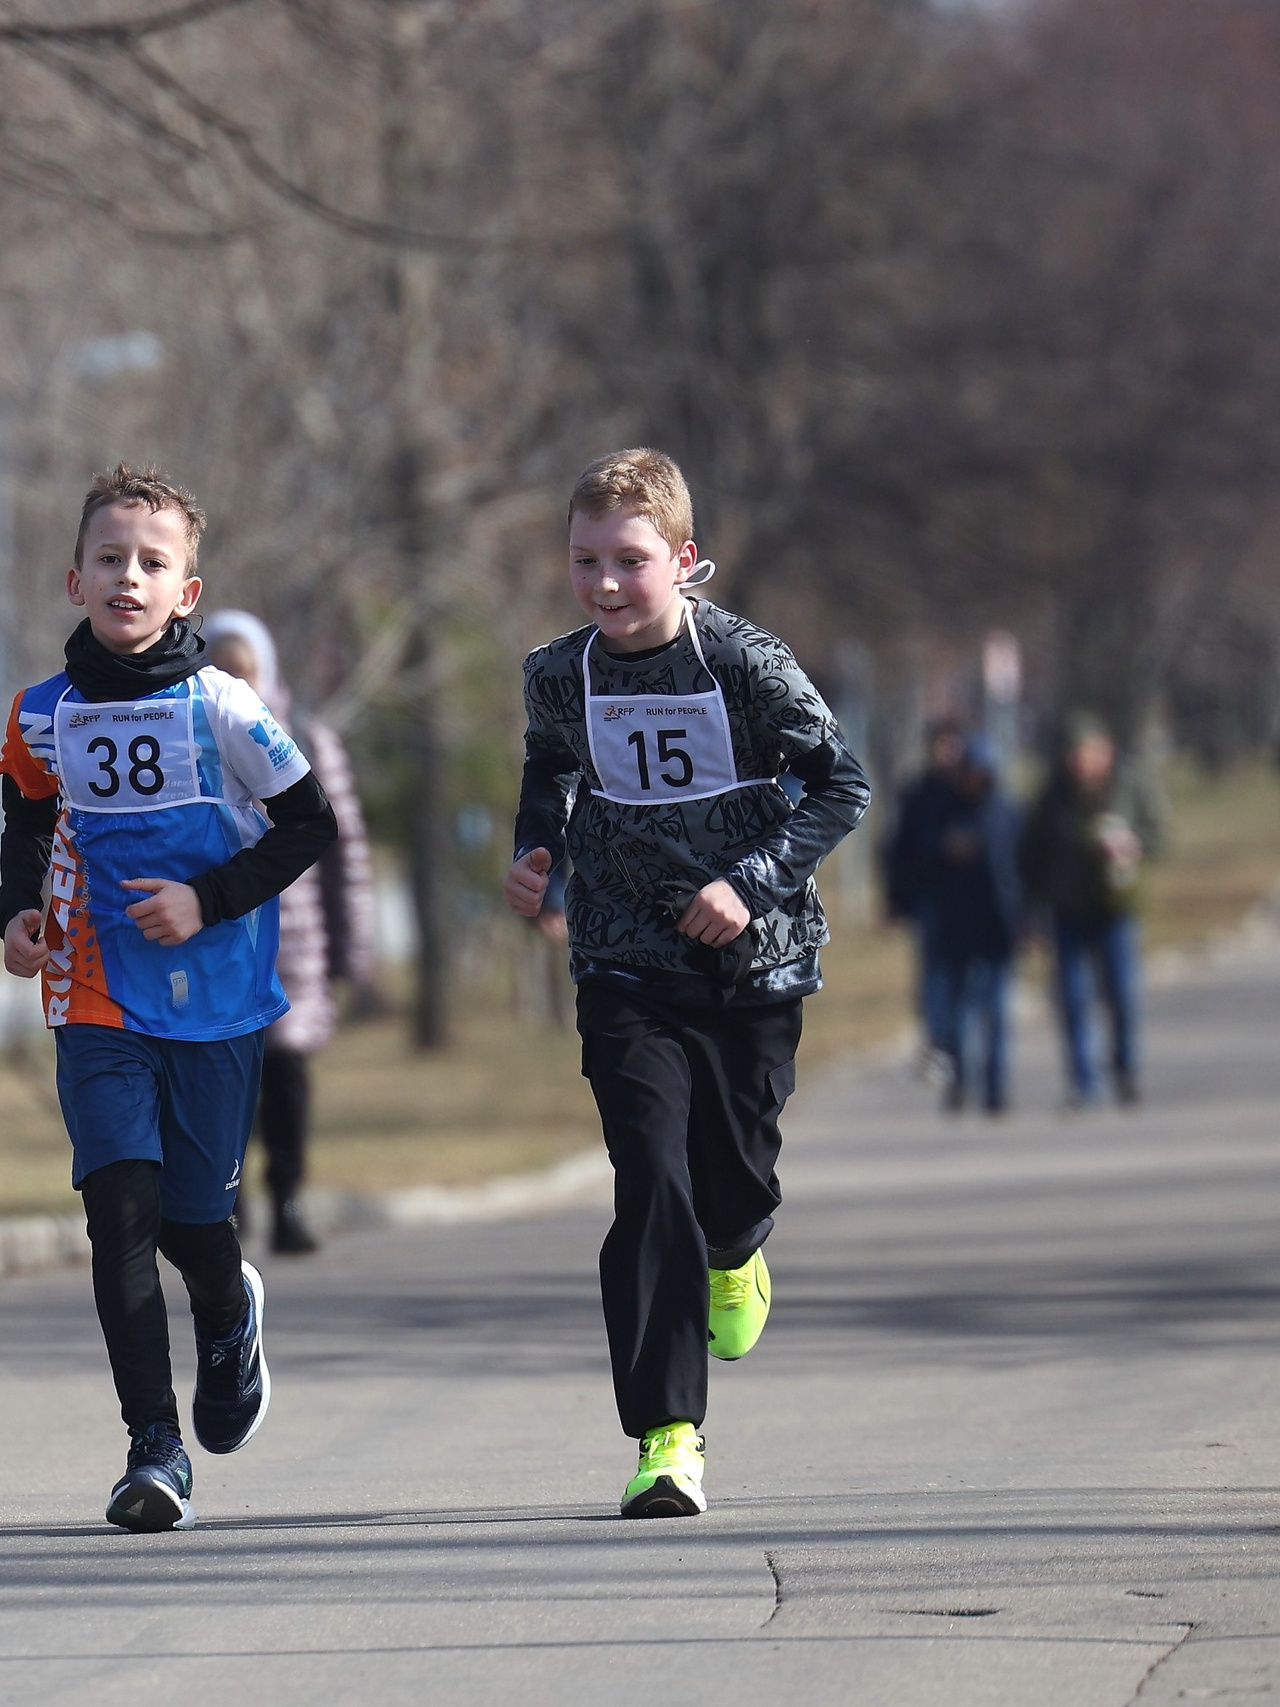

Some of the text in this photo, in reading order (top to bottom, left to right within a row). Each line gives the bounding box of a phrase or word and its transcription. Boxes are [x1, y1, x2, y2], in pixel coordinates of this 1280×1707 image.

[112, 711, 175, 723] RUN for PEOPLE
[617, 707, 635, 717] RFP
[646, 707, 708, 716] RUN for PEOPLE
[267, 740, 287, 760] RUN
[86, 734, 165, 798] 38
[627, 729, 694, 791] 15
